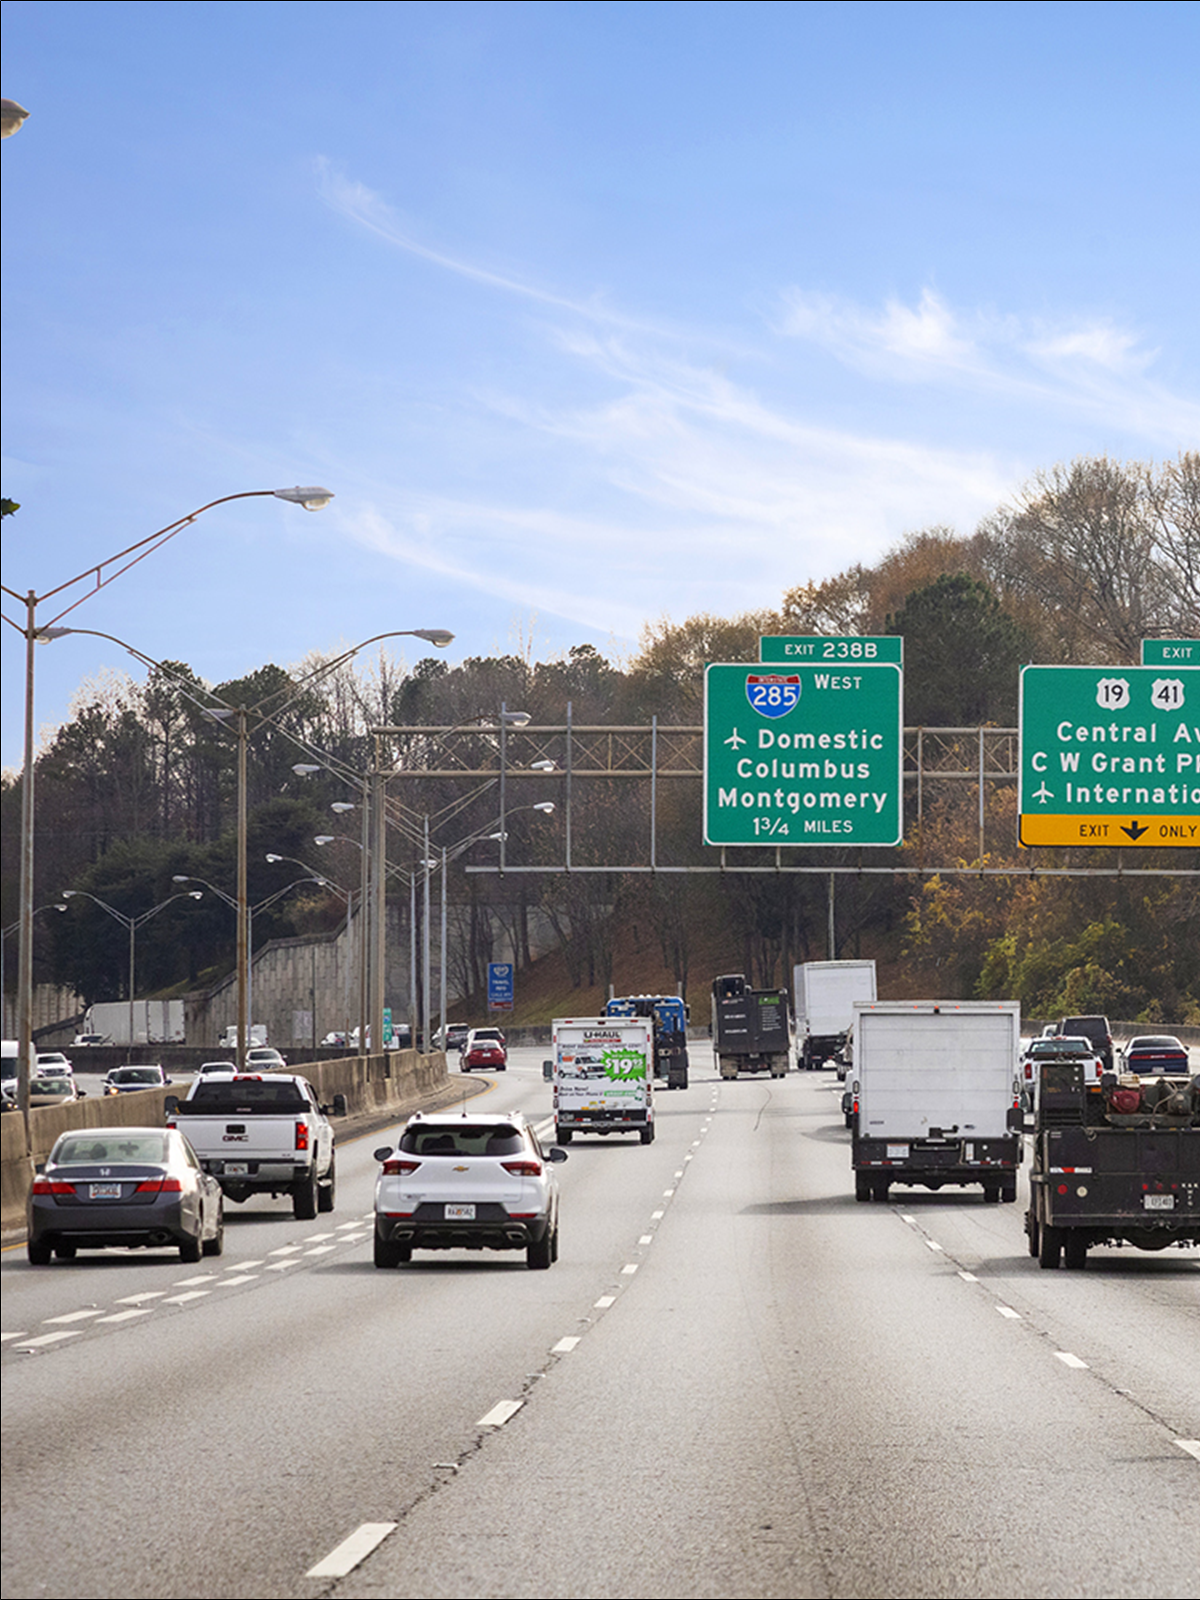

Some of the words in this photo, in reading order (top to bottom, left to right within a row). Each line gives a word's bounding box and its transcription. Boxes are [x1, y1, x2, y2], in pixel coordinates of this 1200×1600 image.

[785, 644, 815, 655] EXIT
[822, 642, 878, 658] 238B
[1162, 647, 1193, 659] EXIT
[814, 674, 863, 689] WEST
[753, 686, 797, 706] 285
[1103, 684, 1124, 703] 19
[1157, 685, 1178, 703] 41
[758, 729, 883, 749] Domestic
[1057, 721, 1156, 743] Central
[737, 758, 870, 778] Columbus
[1031, 751, 1048, 772] C
[1060, 752, 1080, 773] W
[1091, 752, 1166, 773] Grant
[718, 787, 888, 814] Montgomery
[804, 820, 854, 833] MILES
[1079, 824, 1110, 837] EXIT
[1159, 825, 1198, 838] ONLY
